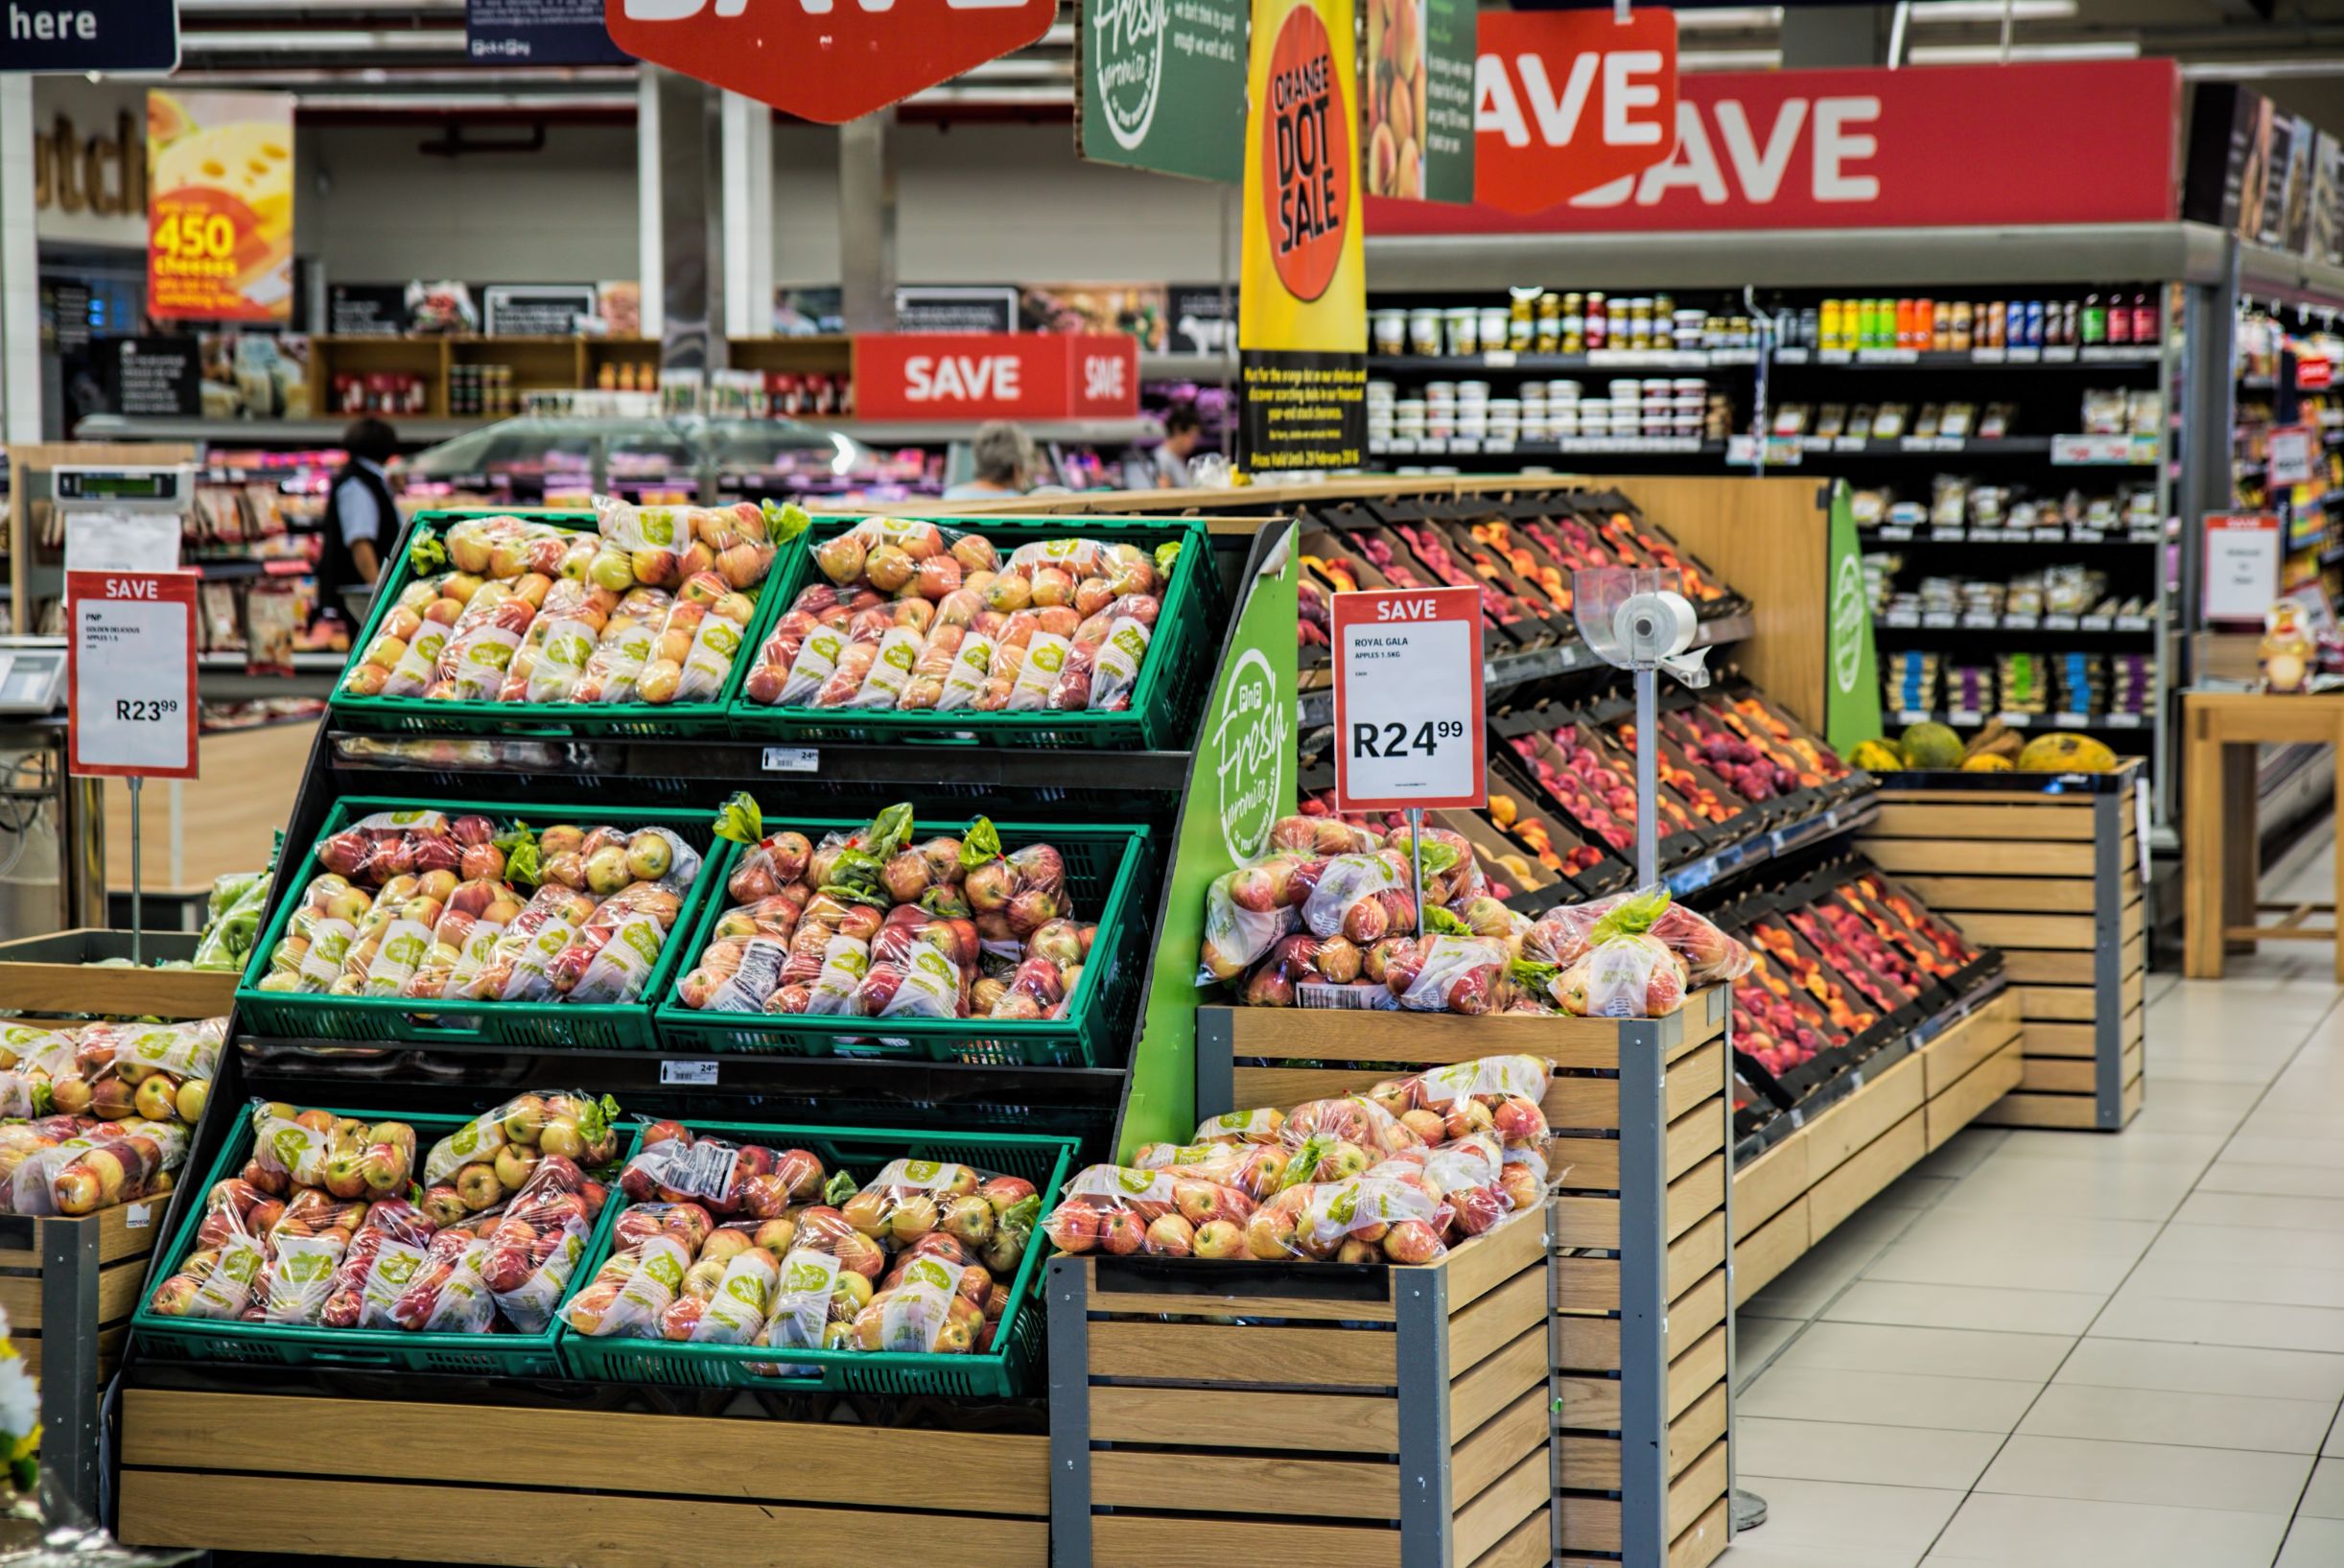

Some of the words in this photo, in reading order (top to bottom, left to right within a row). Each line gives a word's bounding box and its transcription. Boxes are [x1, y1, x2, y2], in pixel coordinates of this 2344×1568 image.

[9, 4, 98, 41] here
[1275, 54, 1329, 112] ORANGE
[1474, 52, 1664, 148] AVE
[1277, 95, 1329, 188] DOT
[1569, 97, 1881, 207] AVE
[1280, 168, 1339, 255] SALE
[153, 214, 235, 259] 450
[903, 355, 1021, 401] SAVE
[1084, 355, 1125, 401] SAVE
[105, 578, 158, 599] SAVE
[1377, 598, 1438, 620] SAVE
[85, 613, 102, 621] PNP
[1354, 638, 1385, 647] ROYAL
[1385, 637, 1409, 646] GALA
[1239, 682, 1263, 714] PnP
[1212, 670, 1289, 791] Fresh
[1227, 778, 1267, 848] promise
[1240, 839, 1253, 853] your
